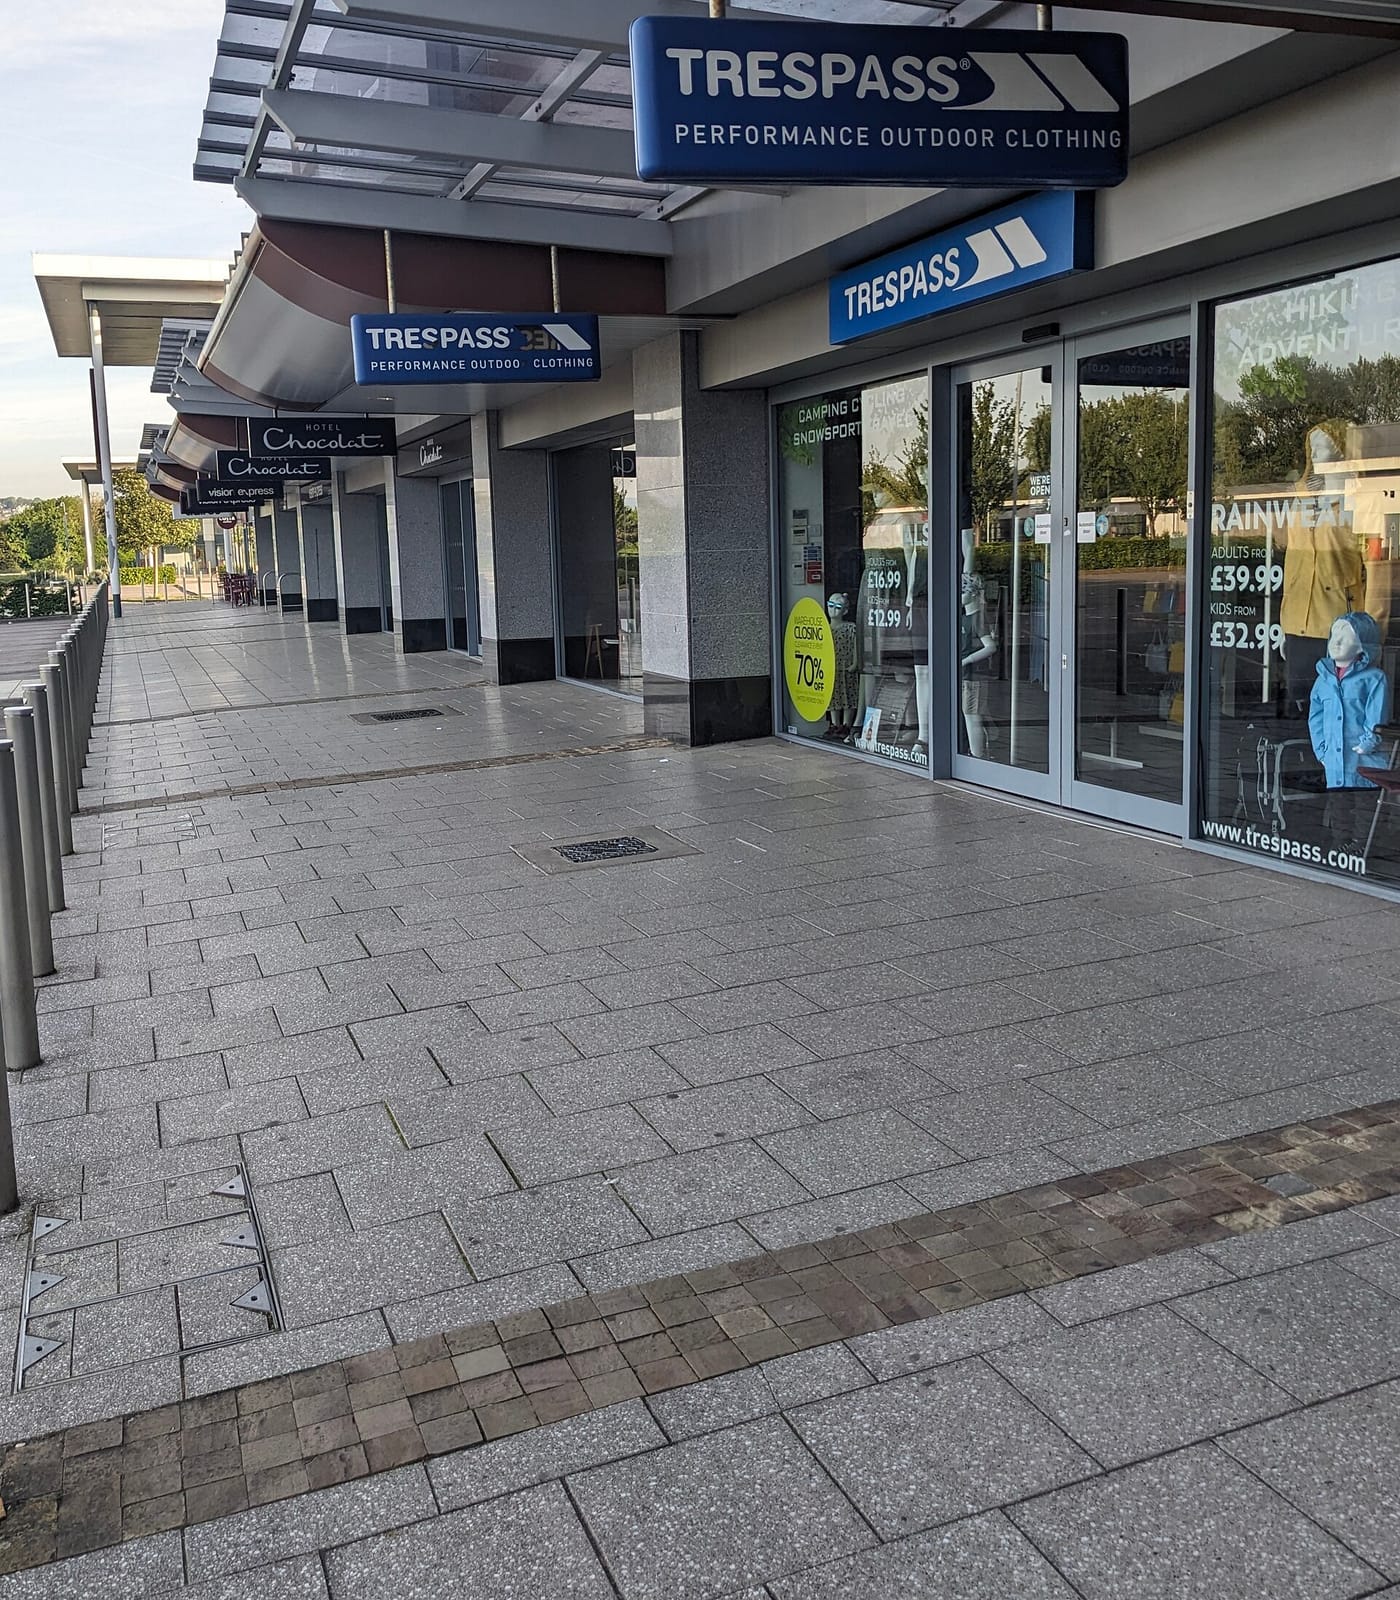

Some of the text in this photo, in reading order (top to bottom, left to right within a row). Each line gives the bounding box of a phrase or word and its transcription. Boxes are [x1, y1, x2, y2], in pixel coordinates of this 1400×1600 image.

[675, 123, 1122, 149] PERFORMANCE OUTDOOR CLOTHING
[844, 247, 960, 321] TRESPASS
[365, 327, 511, 350] TRESPASS
[371, 360, 466, 371] PERFORMANCE
[533, 358, 594, 368] CLOTHING
[798, 400, 848, 423] CAMPING
[306, 423, 341, 431] HOTEL
[1030, 485, 1051, 496] OPEN
[1211, 546, 1275, 559] ADULTS FROM
[867, 570, 901, 589] £16.99
[1210, 564, 1284, 592] £39.99
[867, 608, 901, 628] £12.99
[1210, 602, 1256, 616] KIDS FROM
[793, 626, 823, 641] CLOSING
[1210, 621, 1284, 650] £32.99
[795, 653, 824, 687] 70%
[813, 682, 825, 691] OFF
[1202, 820, 1366, 875] www.trespass.com
